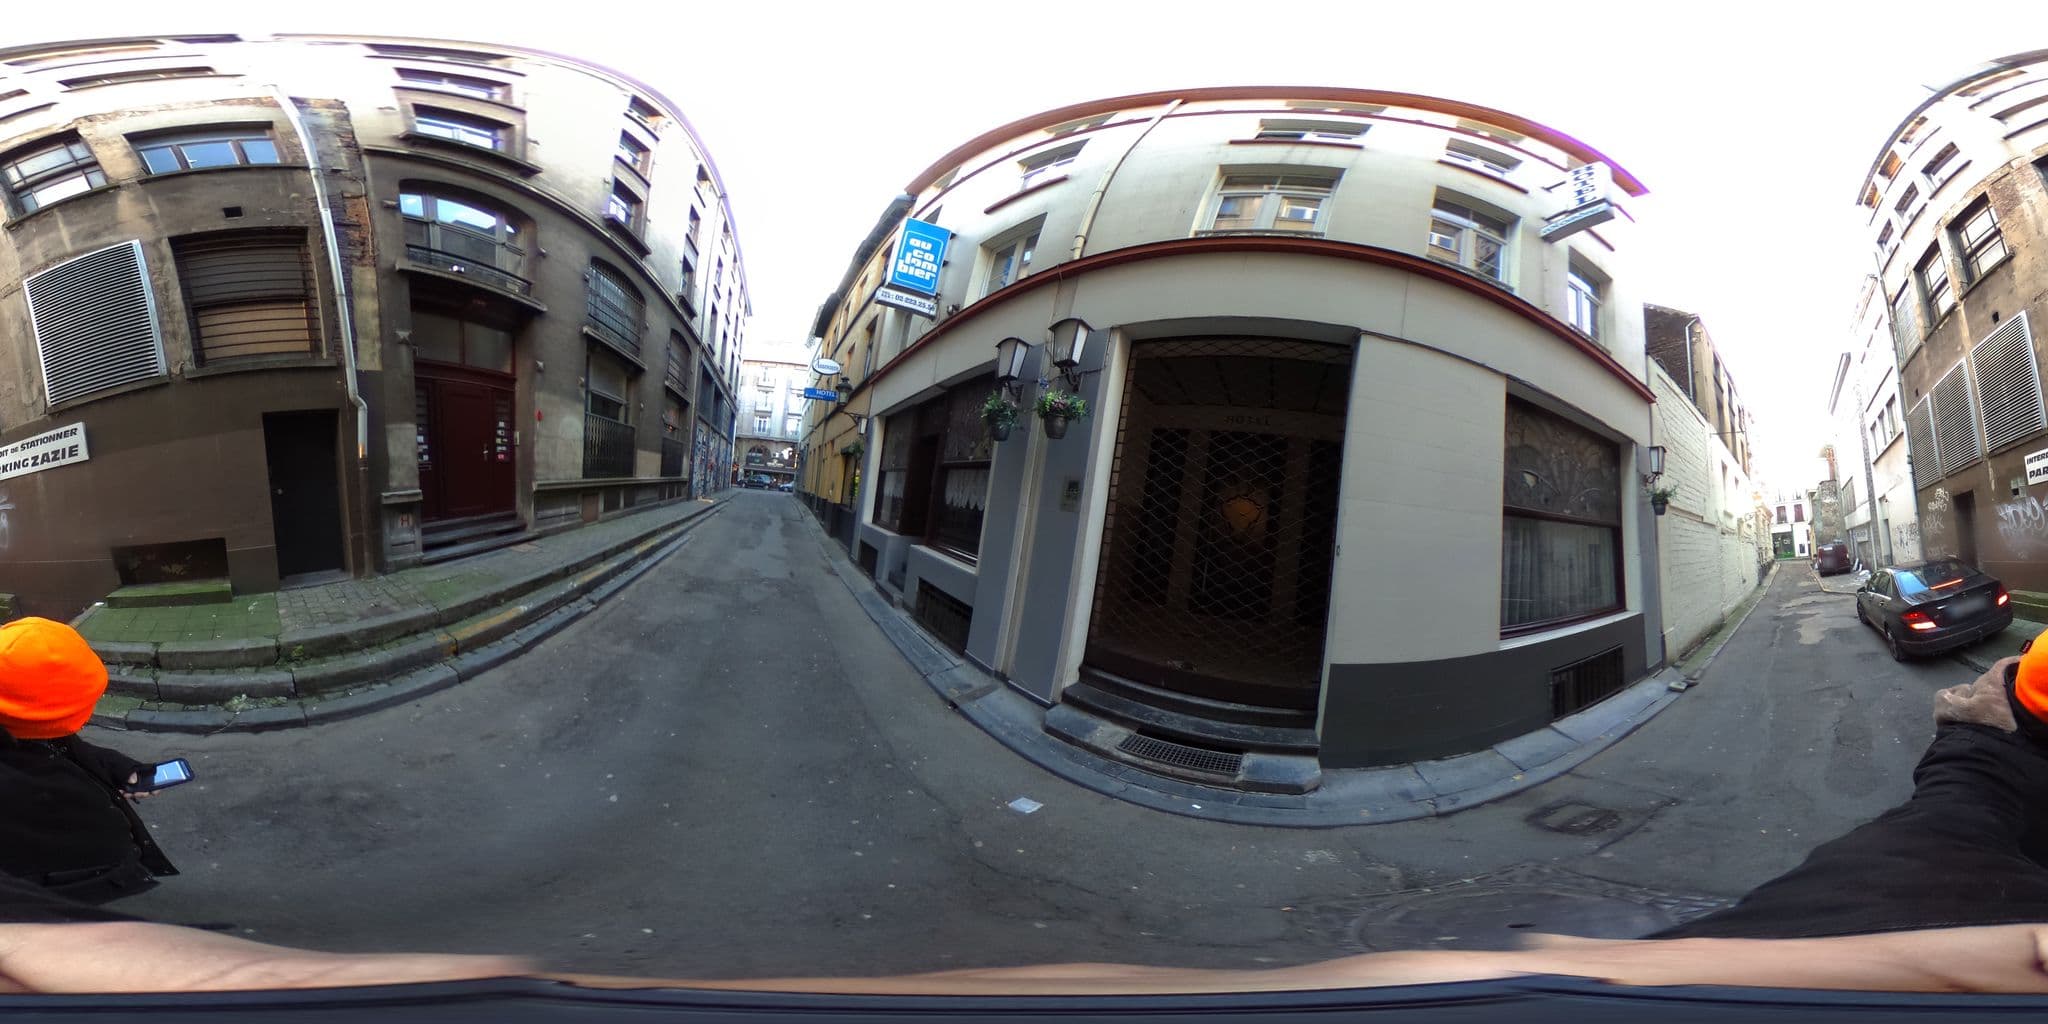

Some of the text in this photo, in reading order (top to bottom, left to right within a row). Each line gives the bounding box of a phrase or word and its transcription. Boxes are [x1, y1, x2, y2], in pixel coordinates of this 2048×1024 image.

[909, 238, 933, 250] au
[912, 249, 935, 262] co
[20, 427, 78, 452] STATIONNER
[0, 444, 79, 474] KING ZAZIE
